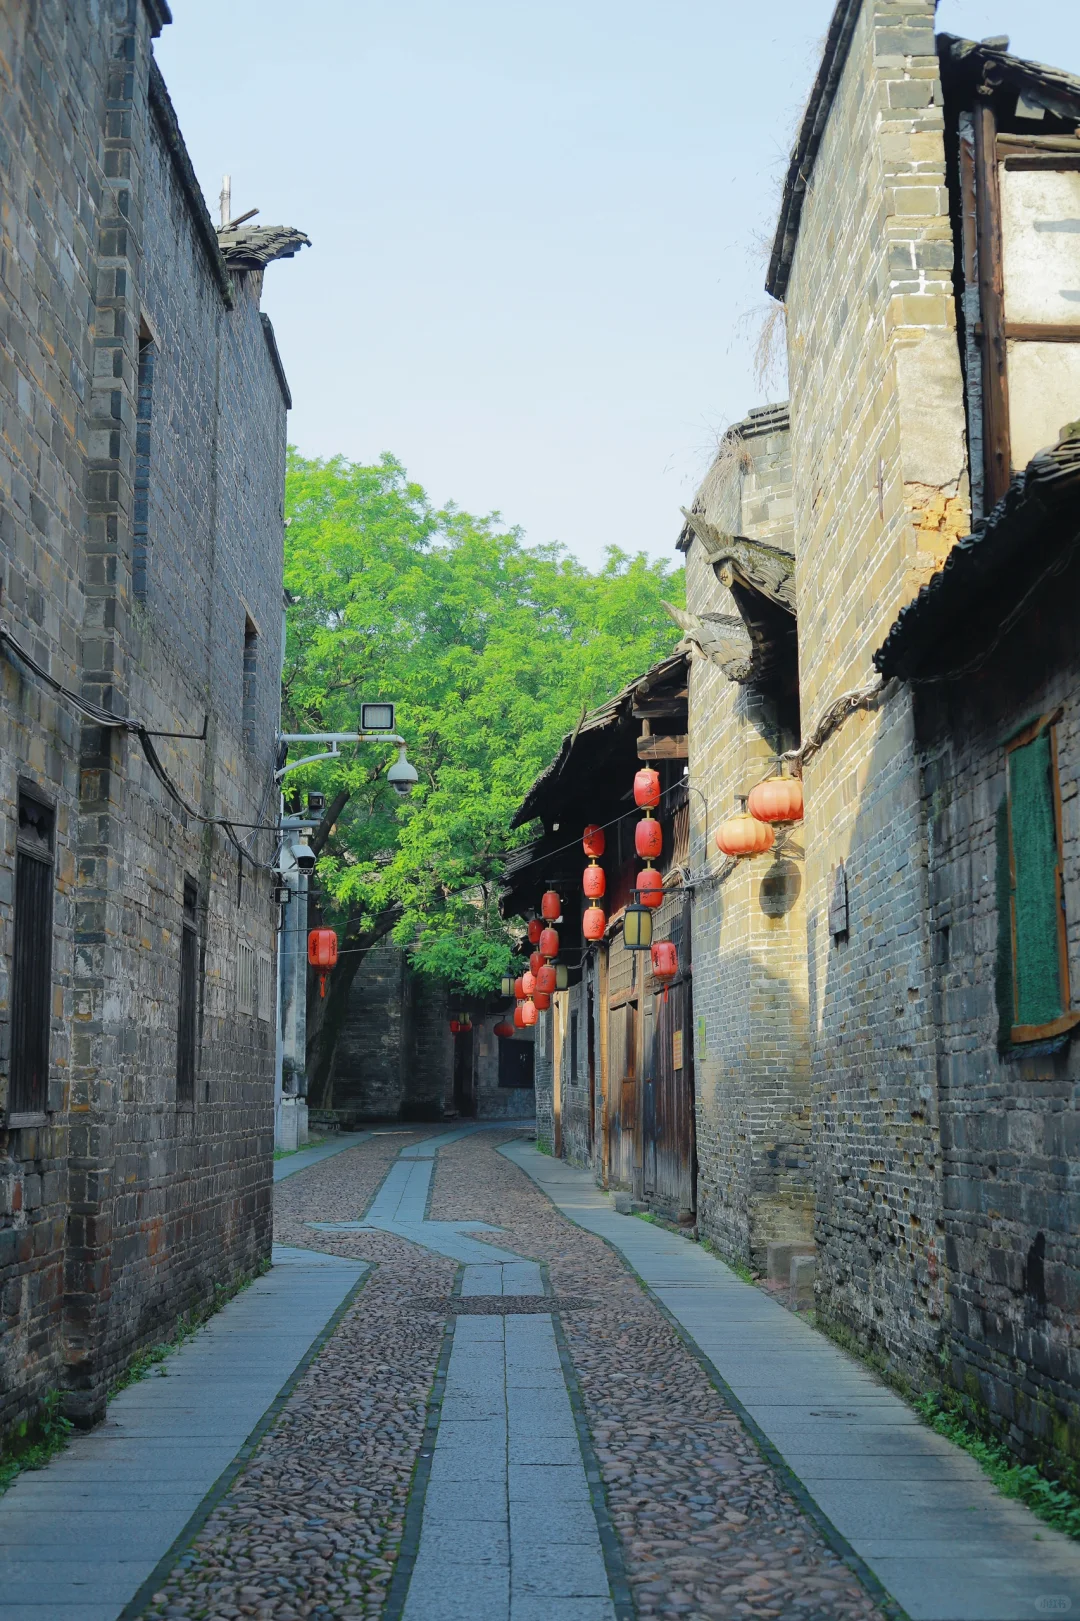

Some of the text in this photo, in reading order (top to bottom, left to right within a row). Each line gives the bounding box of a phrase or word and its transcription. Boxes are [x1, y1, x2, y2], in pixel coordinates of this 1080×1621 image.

[648, 830, 660, 848] 茶
[588, 875, 600, 890] 茶
[589, 917, 601, 933] 茶
